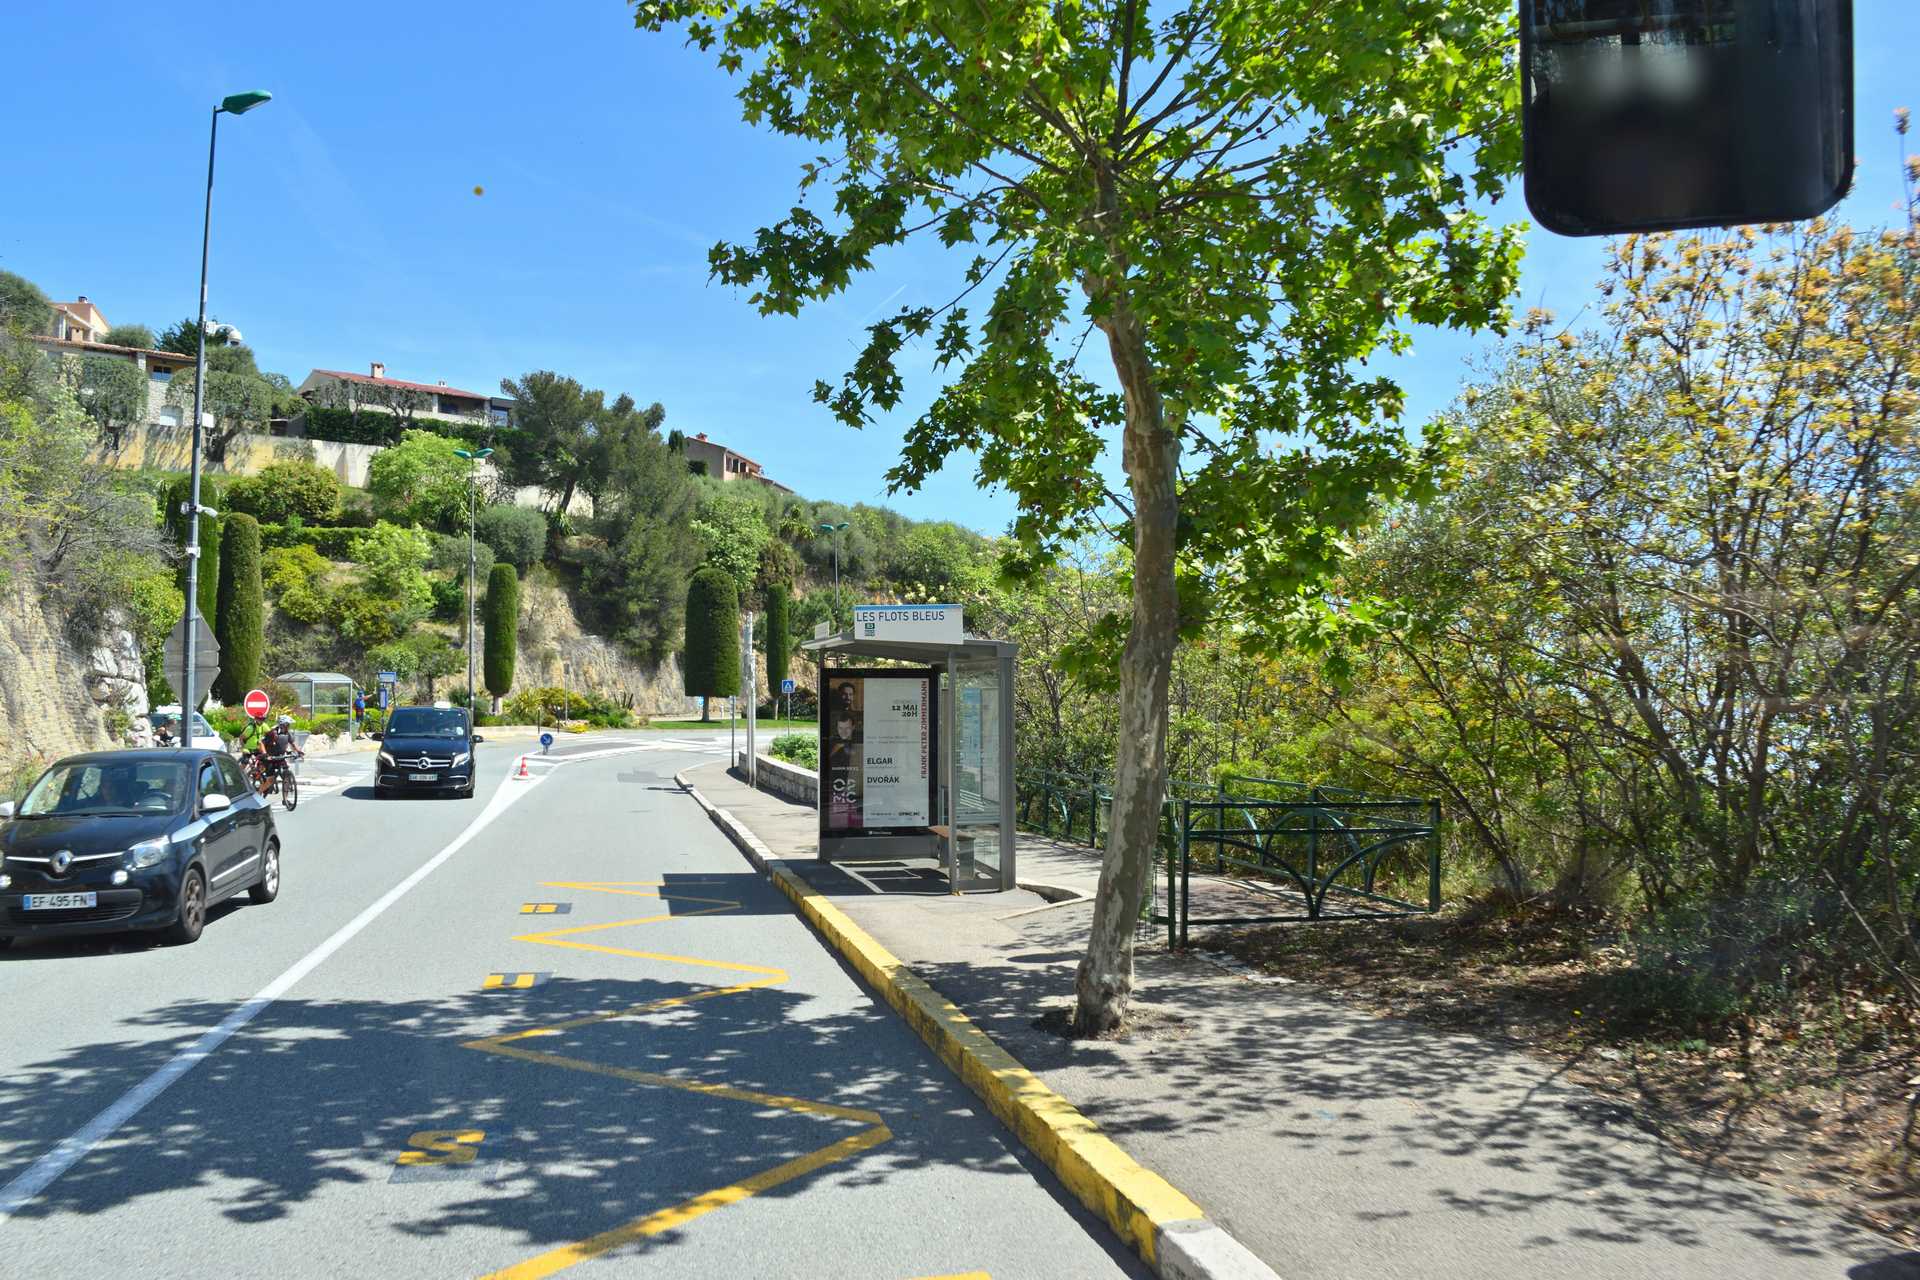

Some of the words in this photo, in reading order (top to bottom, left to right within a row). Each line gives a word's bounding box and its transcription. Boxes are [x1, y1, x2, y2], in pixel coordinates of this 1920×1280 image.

[856, 612, 875, 622] LES
[878, 611, 909, 621] FLOTS
[912, 611, 945, 621] BLEUS
[866, 757, 893, 765] ELGAR
